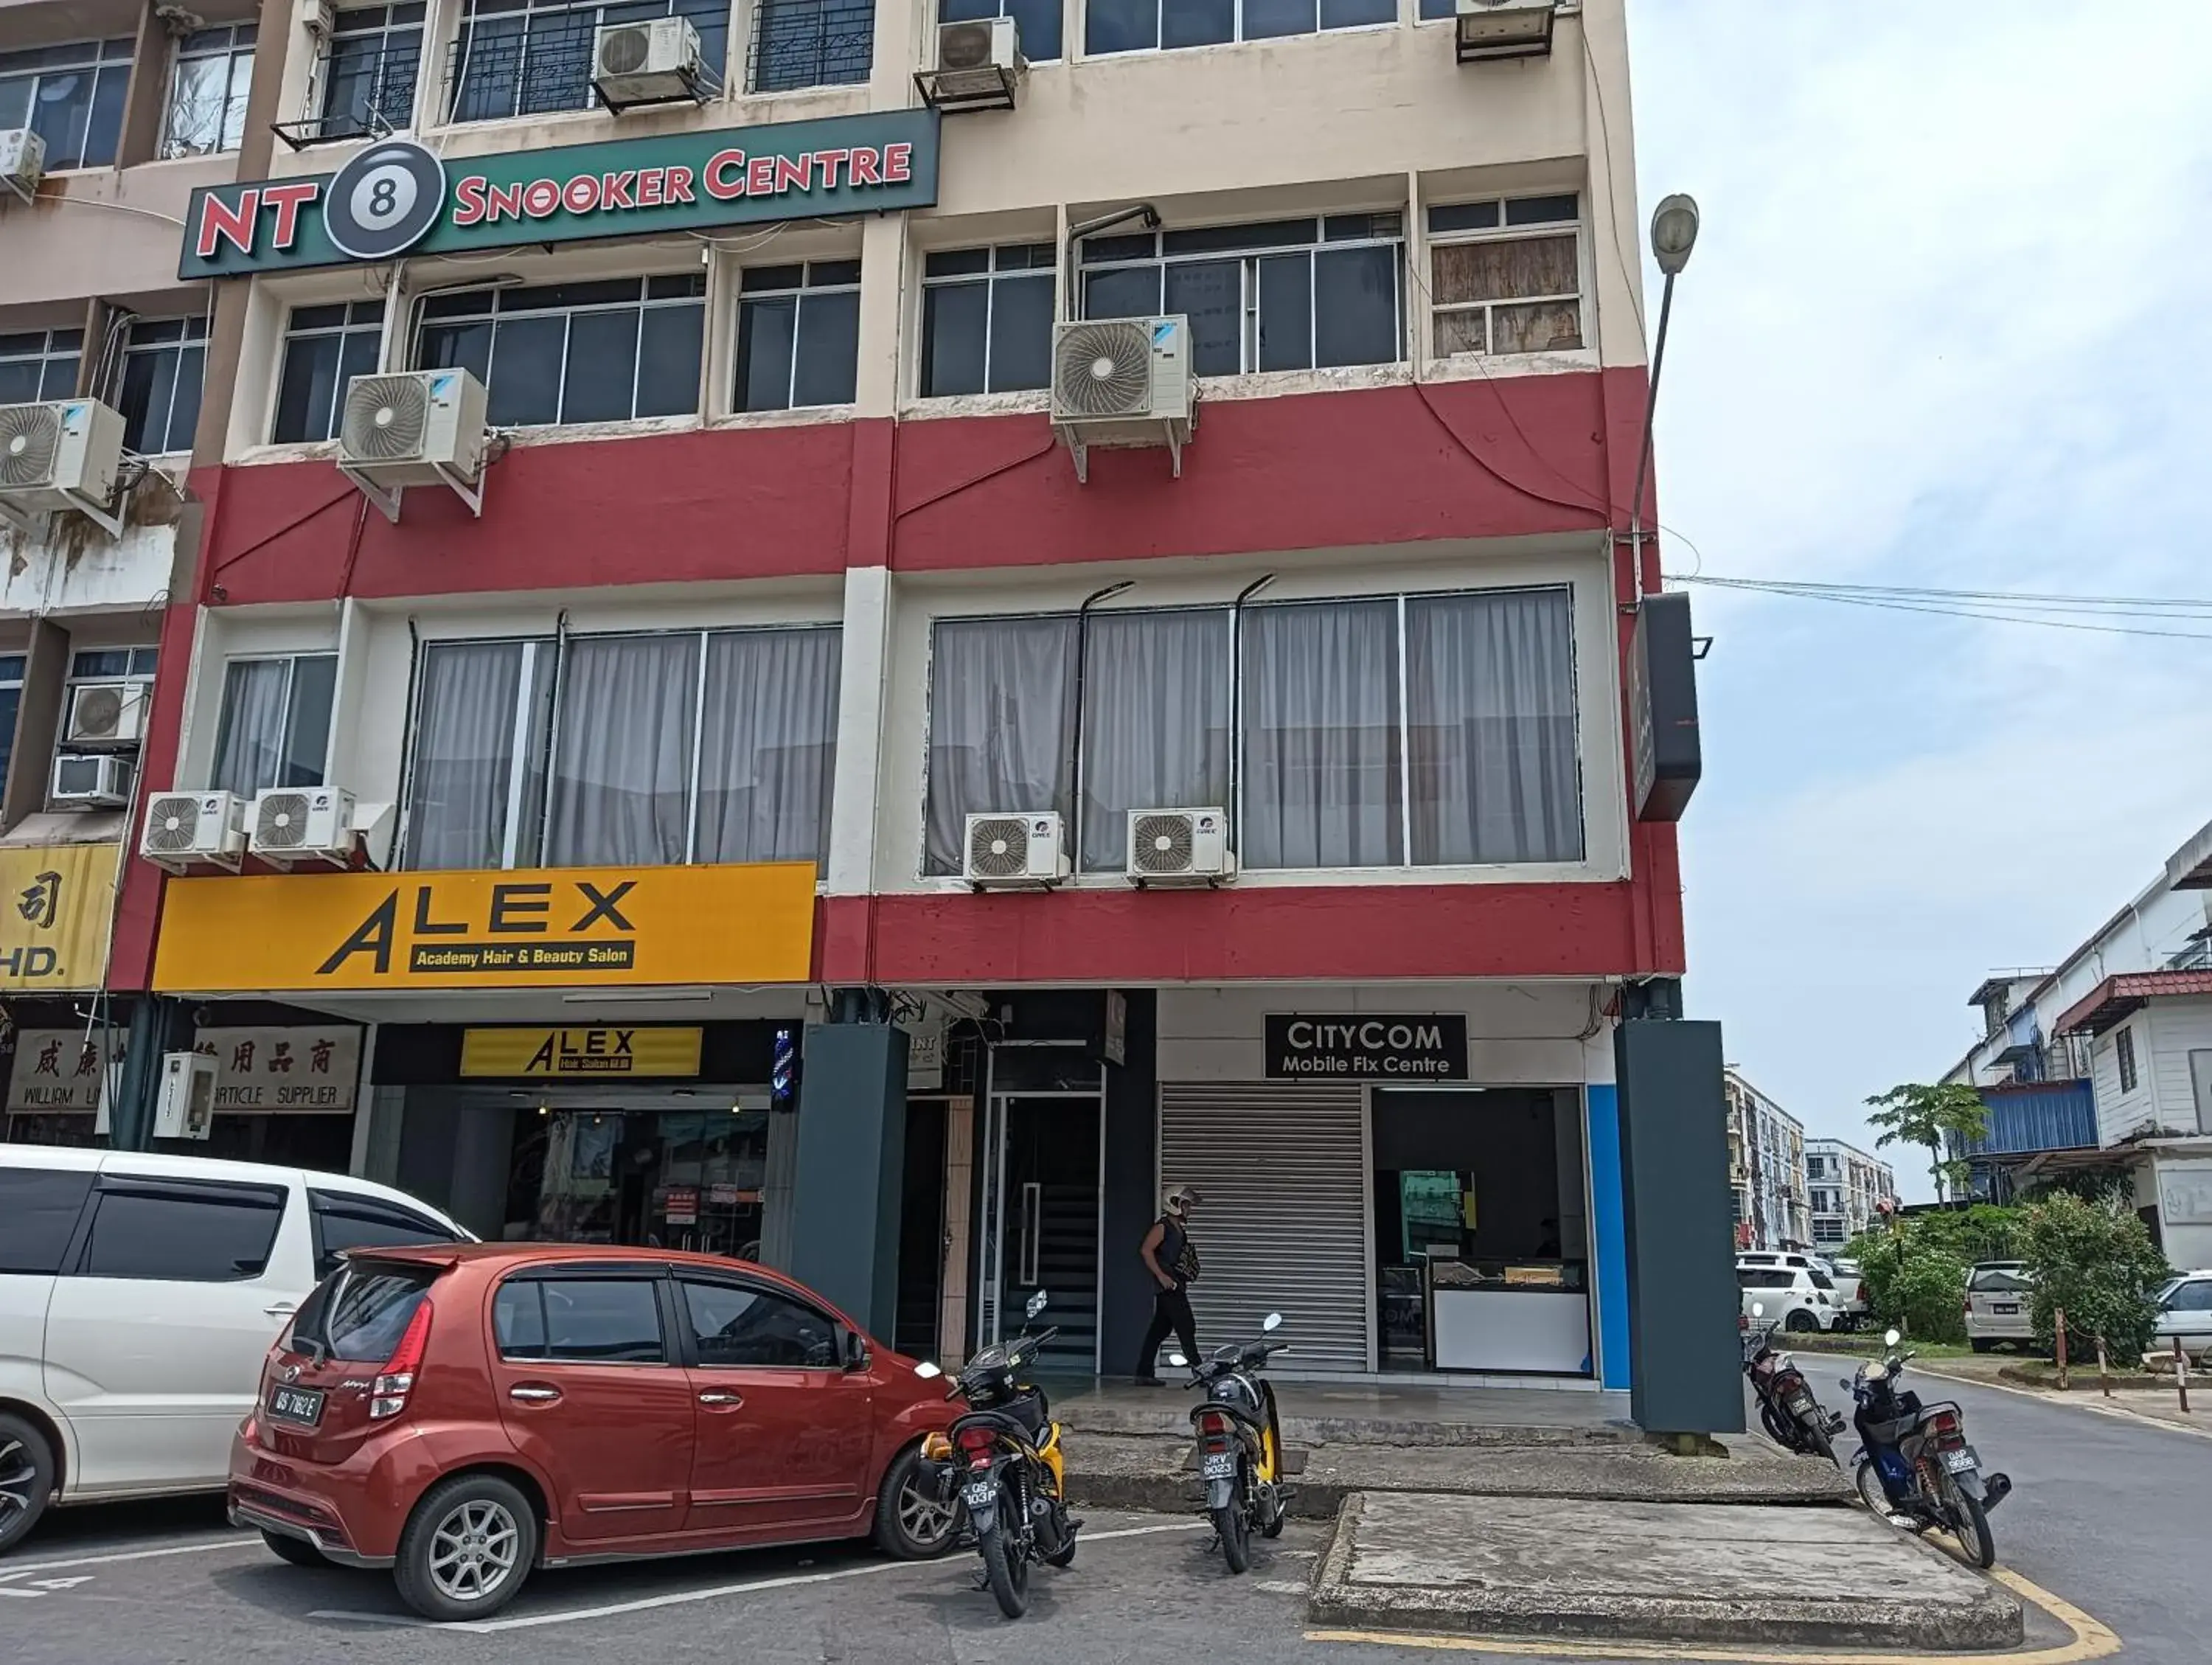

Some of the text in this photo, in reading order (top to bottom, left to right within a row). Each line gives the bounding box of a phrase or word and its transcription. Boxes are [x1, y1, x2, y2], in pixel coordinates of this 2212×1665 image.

[196, 142, 912, 256] NT 8 SNOOKER CENTRE
[17, 871, 63, 929] 司
[314, 881, 639, 974] ALEX
[417, 948, 627, 967] Academy Hair & Beauty Salon
[524, 1029, 636, 1072] ALEX
[1282, 1055, 1450, 1073] Mobile Fix Centre
[24, 1087, 74, 1105] WILLIAM
[277, 1086, 337, 1105] SUPPLIER
